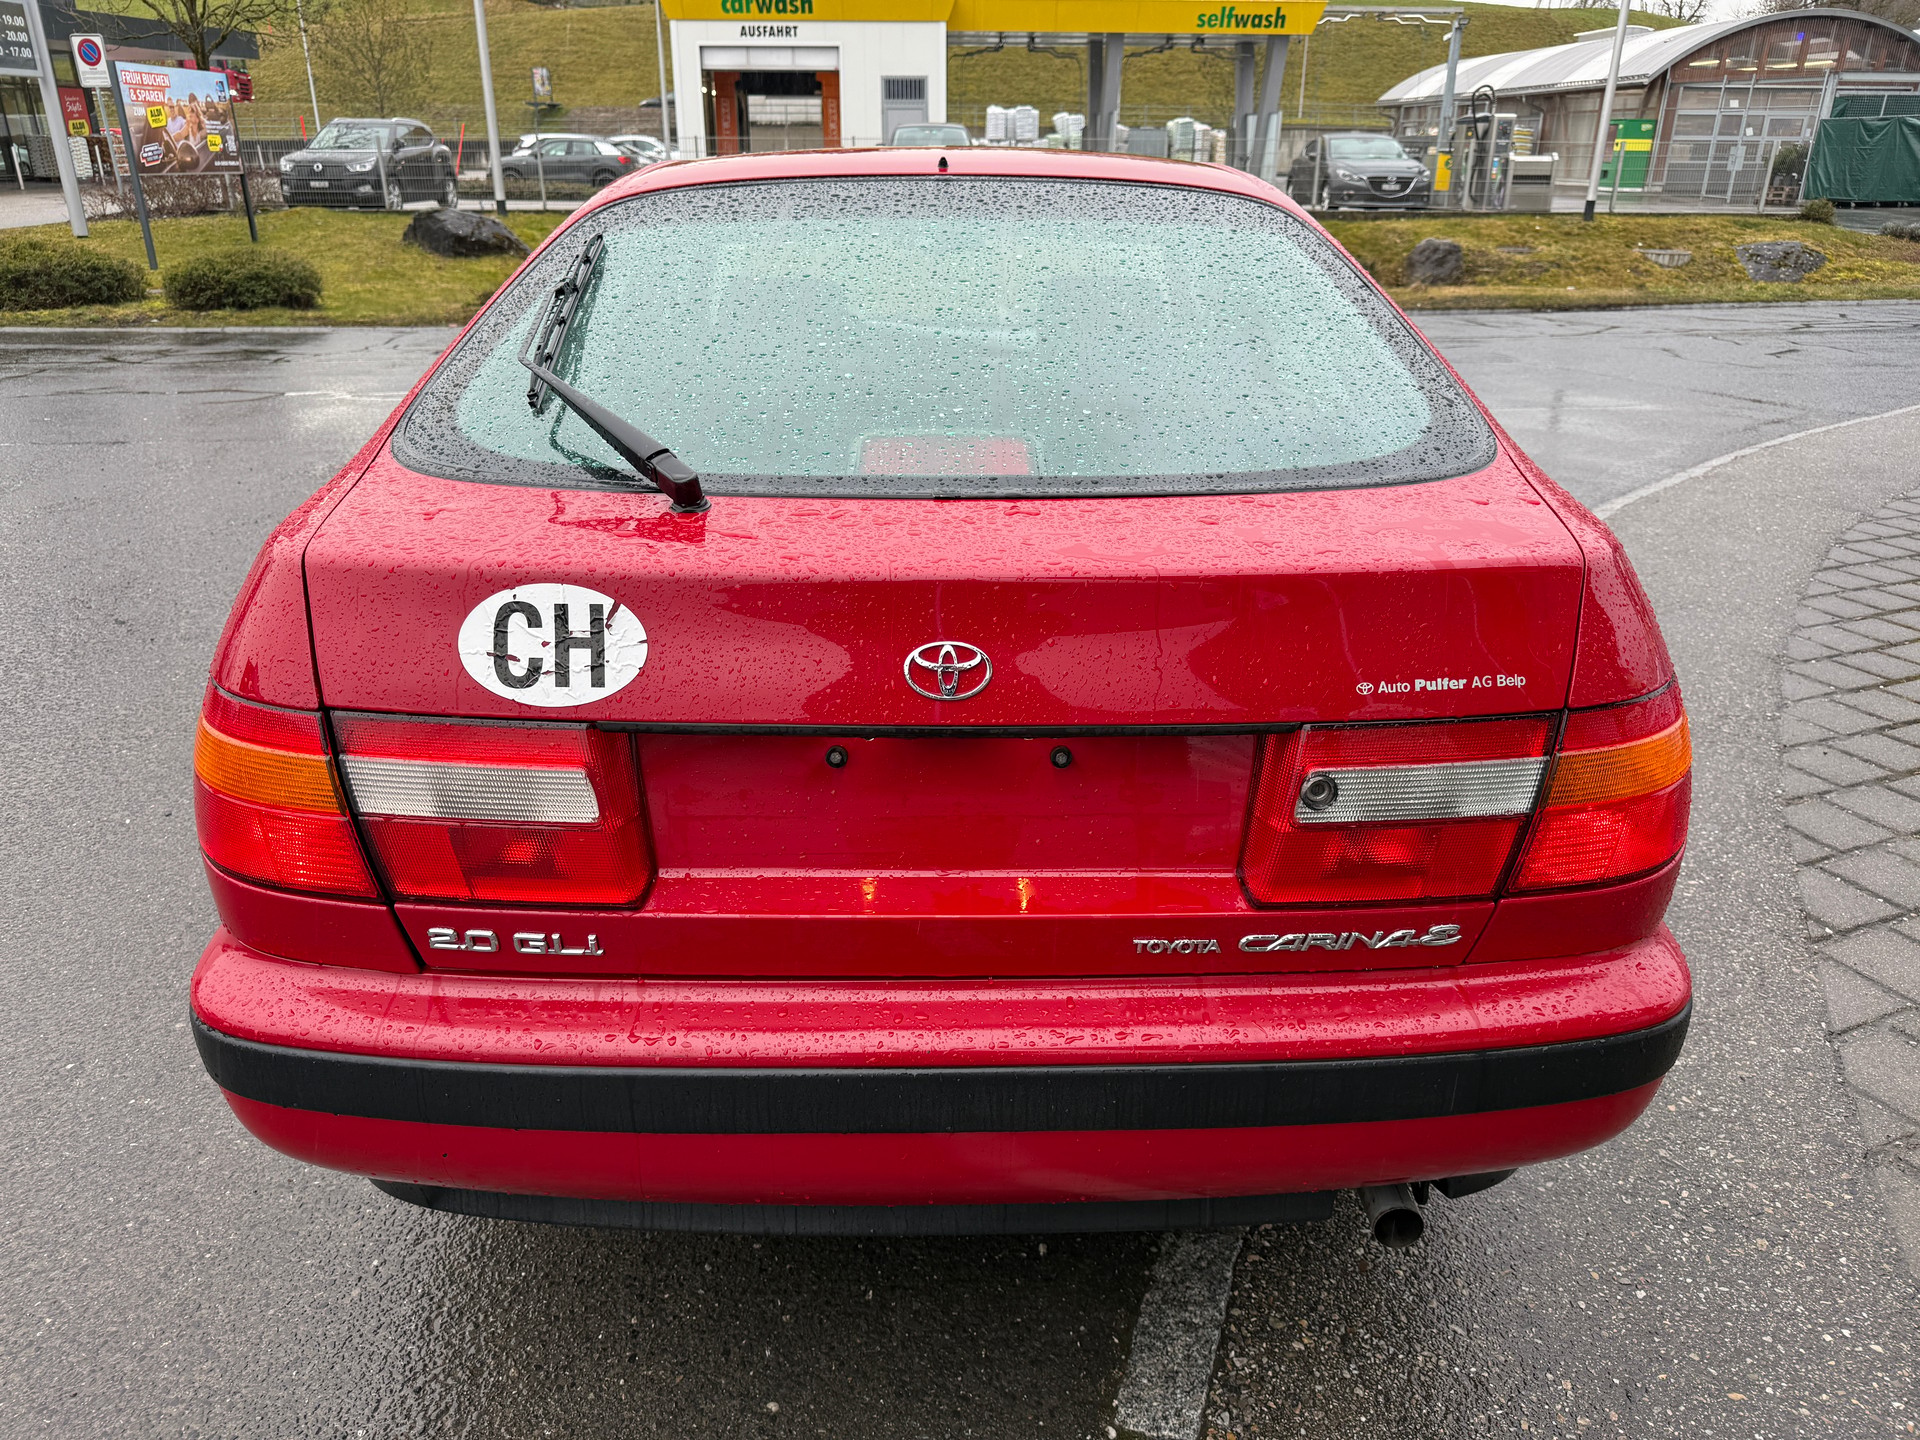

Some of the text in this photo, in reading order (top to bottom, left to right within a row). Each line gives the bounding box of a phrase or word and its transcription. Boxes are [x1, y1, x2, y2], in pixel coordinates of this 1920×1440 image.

[721, 0, 814, 15] carwash
[2, 14, 25, 27] 19.00
[1196, 6, 1287, 29] selfwash
[5, 30, 28, 42] 20.00
[740, 25, 799, 38] AUSFAHRT
[10, 46, 32, 58] 17.00
[121, 71, 141, 84] FRÜH
[141, 73, 170, 87] BUCHEN
[130, 88, 165, 103] & SPAREN
[133, 106, 146, 116] ZUM
[150, 108, 163, 118] ALDI
[72, 121, 86, 130] ALDI
[493, 600, 606, 689] CH
[1377, 674, 1527, 694] Auto Pulfer AG Belp
[427, 927, 500, 953] 2.0
[1132, 937, 1222, 955] TOYOTA
[1238, 928, 1417, 953] CARINA
